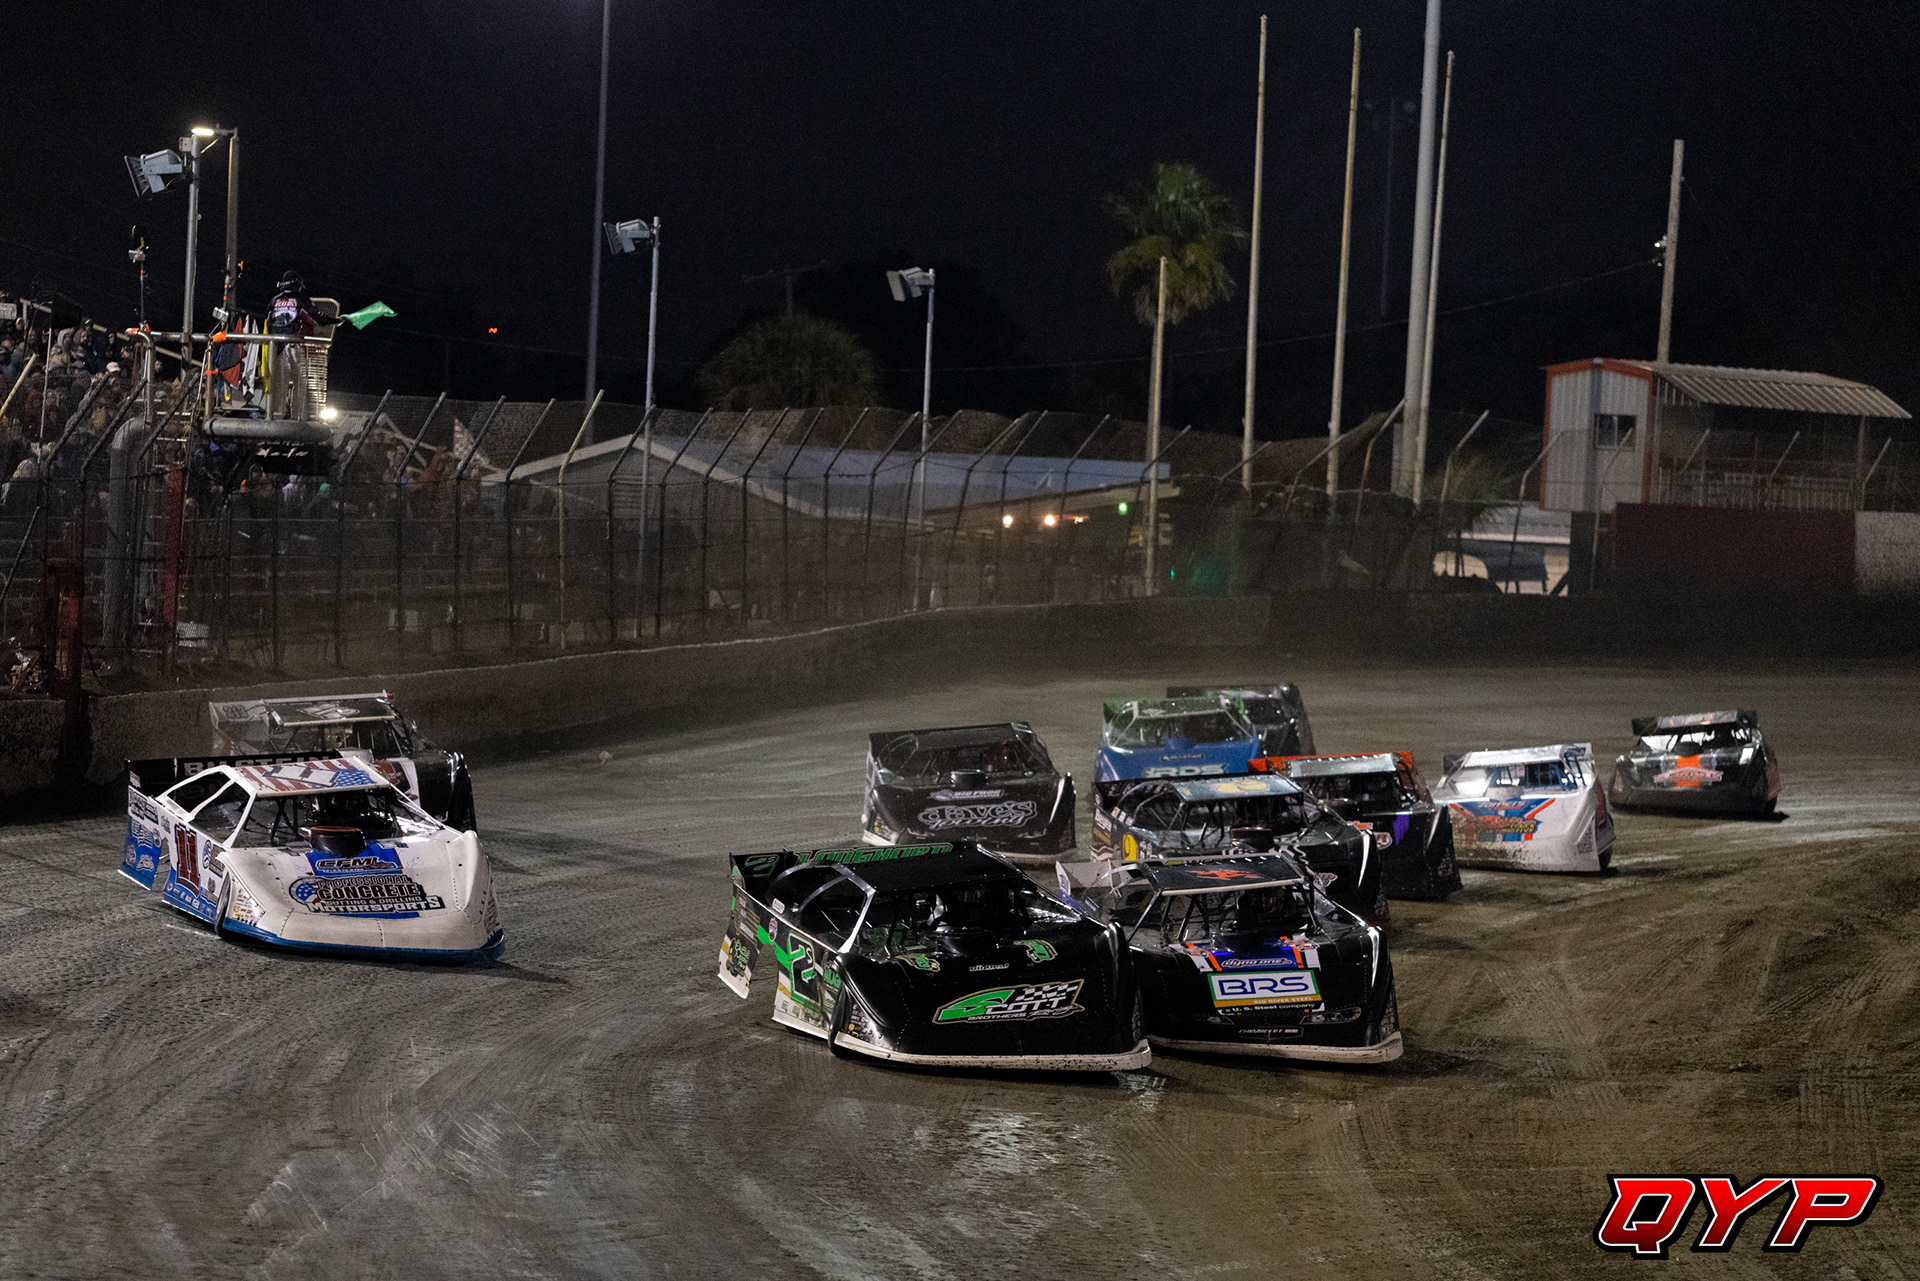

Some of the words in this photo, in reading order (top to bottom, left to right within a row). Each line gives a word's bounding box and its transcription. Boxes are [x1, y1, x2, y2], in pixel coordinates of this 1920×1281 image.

[175, 823, 200, 892] 11
[317, 875, 411, 888] PROFESSIONAL
[317, 884, 421, 901] CONCRETE
[377, 896, 422, 904] DRILLING
[308, 896, 442, 912] MOTORSPORTS
[1218, 976, 1309, 996] BRS
[937, 989, 1067, 1021] SCOTT
[1278, 1003, 1315, 1011] company
[967, 1012, 1027, 1021] BROTHERS
